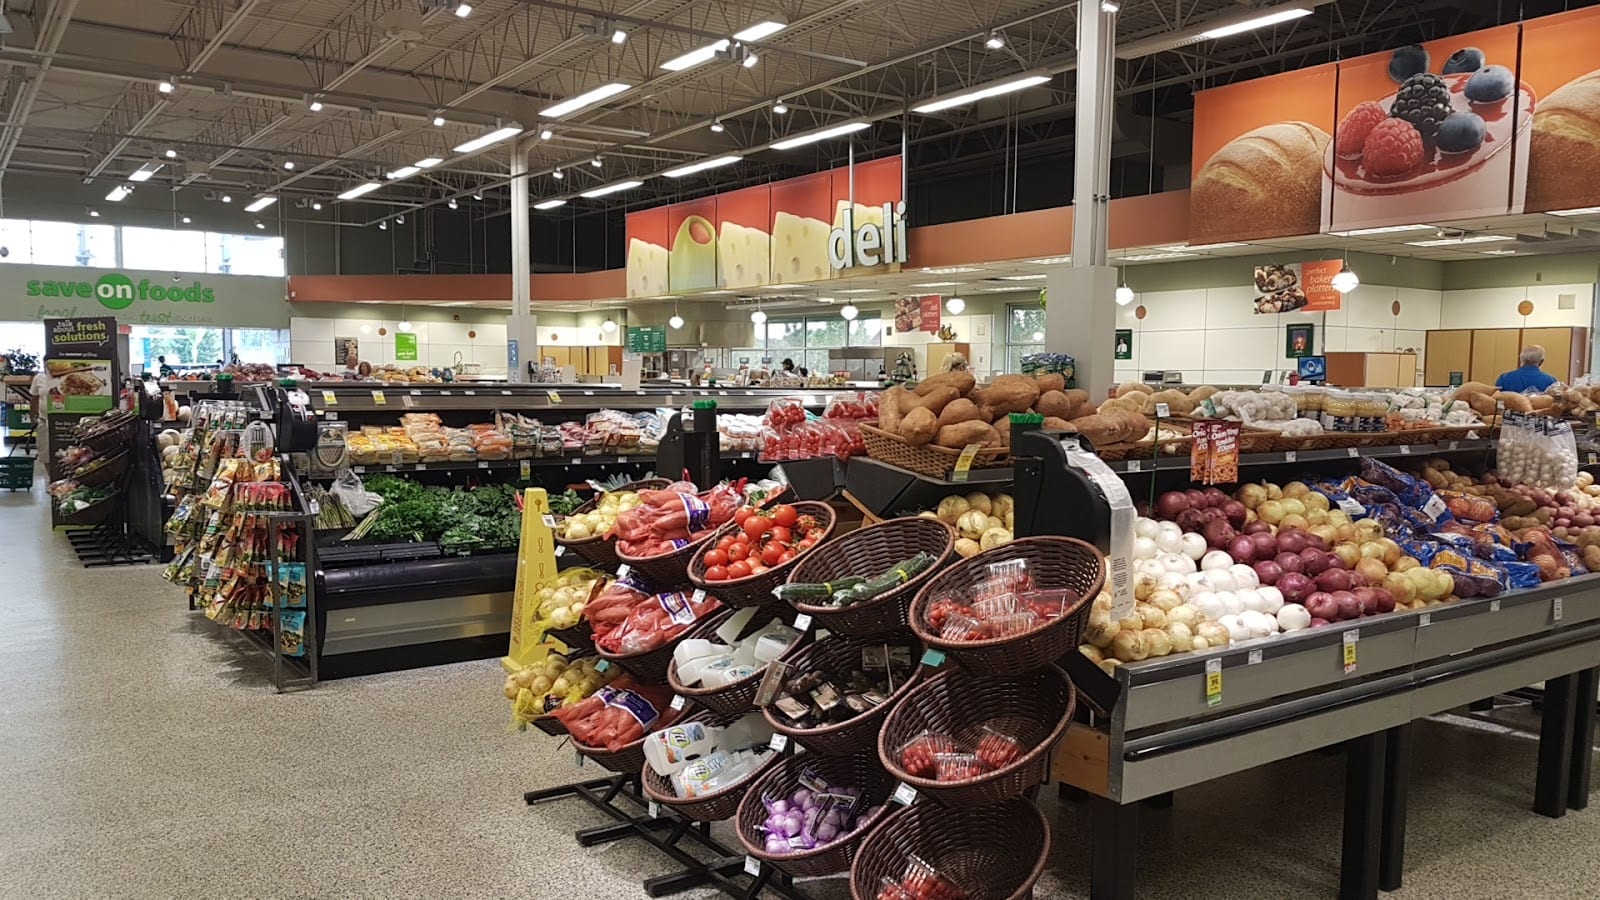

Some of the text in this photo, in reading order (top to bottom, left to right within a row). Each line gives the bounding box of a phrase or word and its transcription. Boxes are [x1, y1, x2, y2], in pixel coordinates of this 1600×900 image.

[827, 200, 908, 270] deli
[26, 278, 216, 303] save on foods
[57, 319, 73, 327] talk
[77, 320, 106, 331] fresh
[54, 331, 106, 342] solutions
